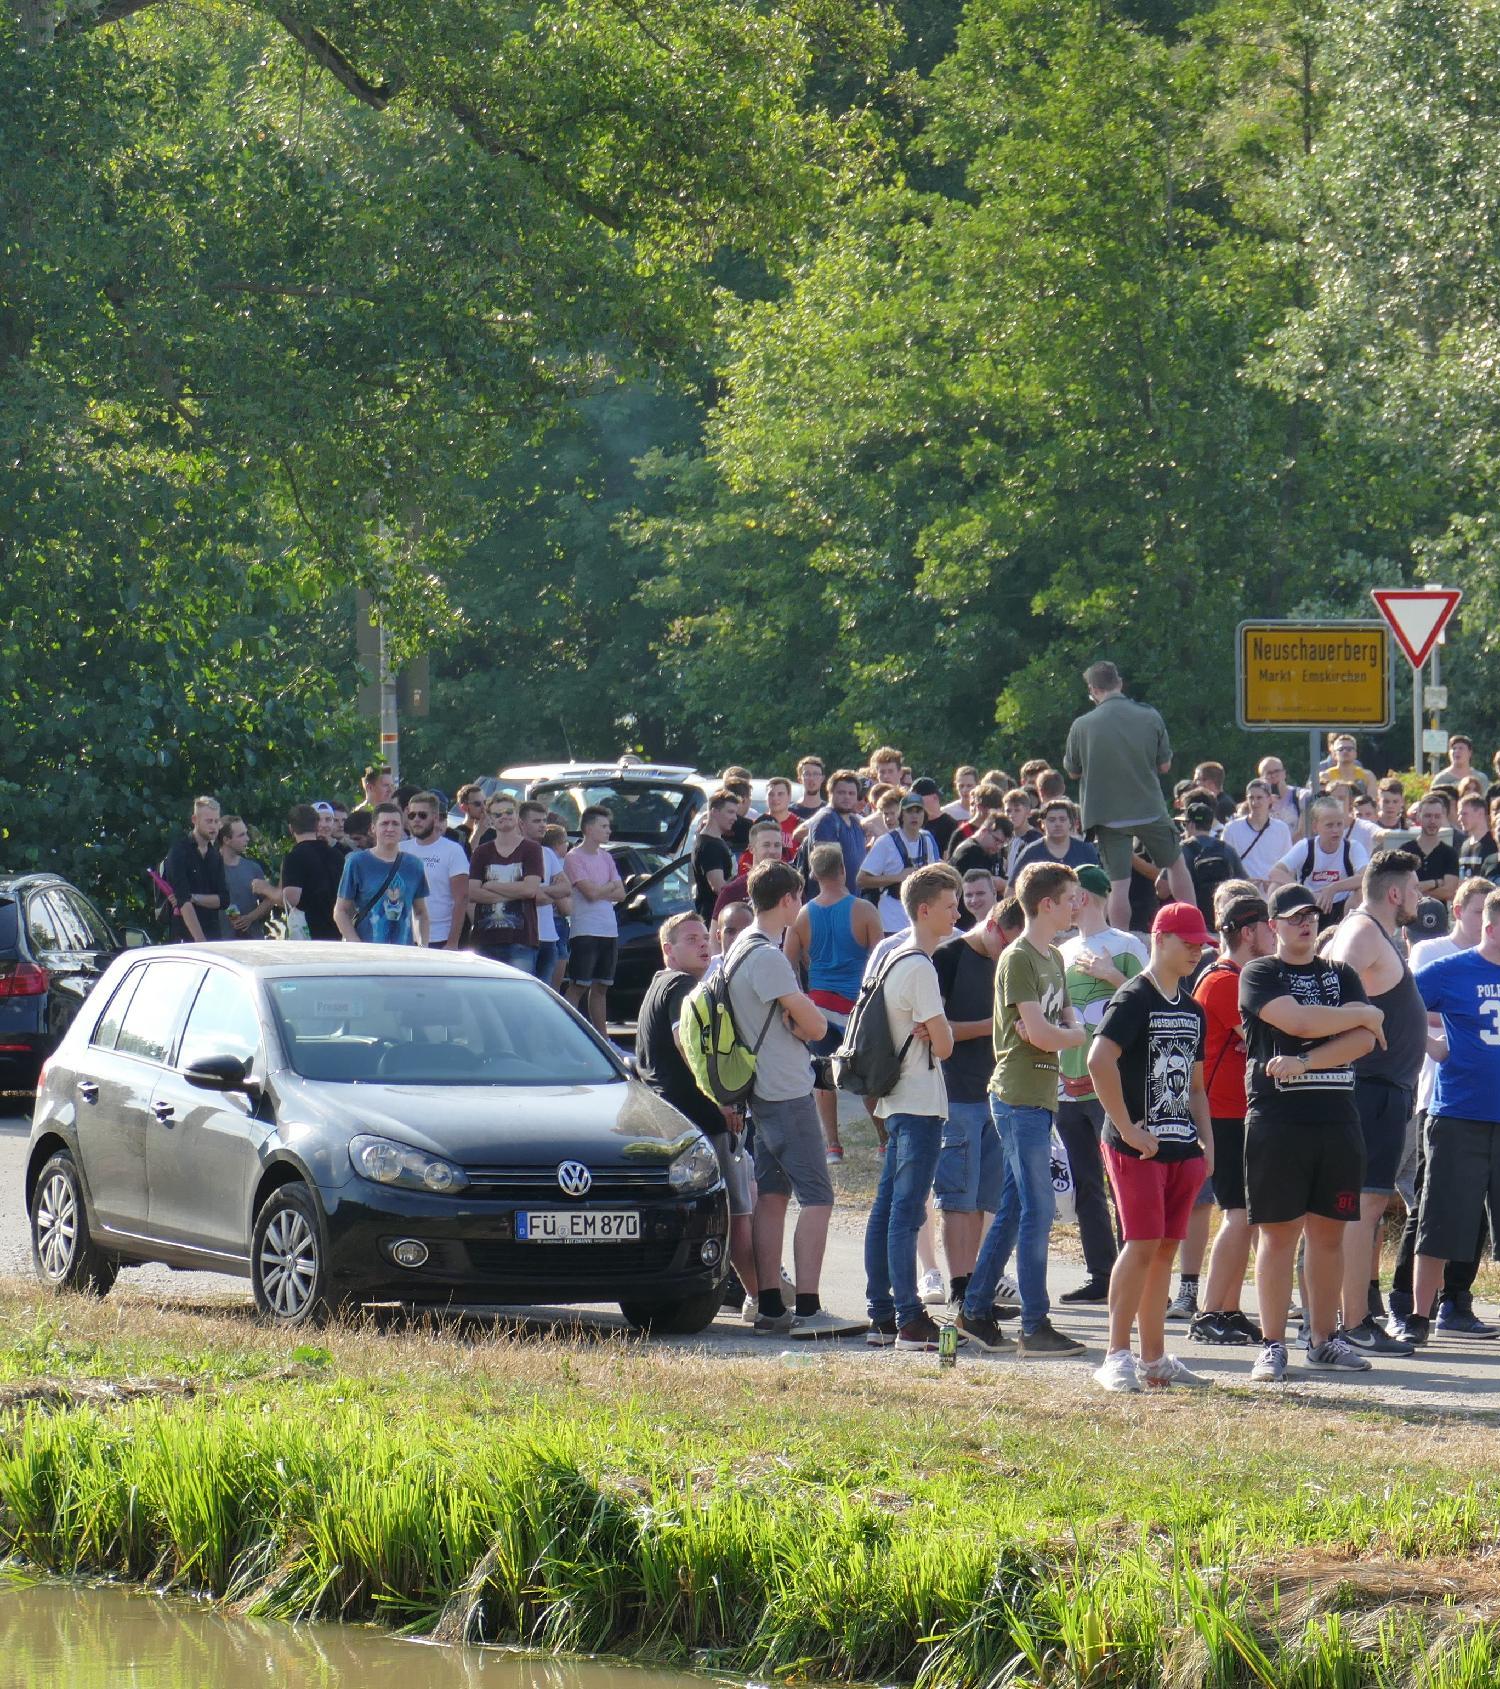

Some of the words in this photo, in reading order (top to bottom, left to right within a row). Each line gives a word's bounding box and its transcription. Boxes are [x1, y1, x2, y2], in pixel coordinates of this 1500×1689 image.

[1253, 637, 1377, 668] Neuschauerberg
[1259, 669, 1291, 682] Markt
[1302, 669, 1367, 683] Emskirchen
[529, 1215, 556, 1235] FÜ
[570, 1215, 596, 1236] EM
[601, 1215, 638, 1236] 870
